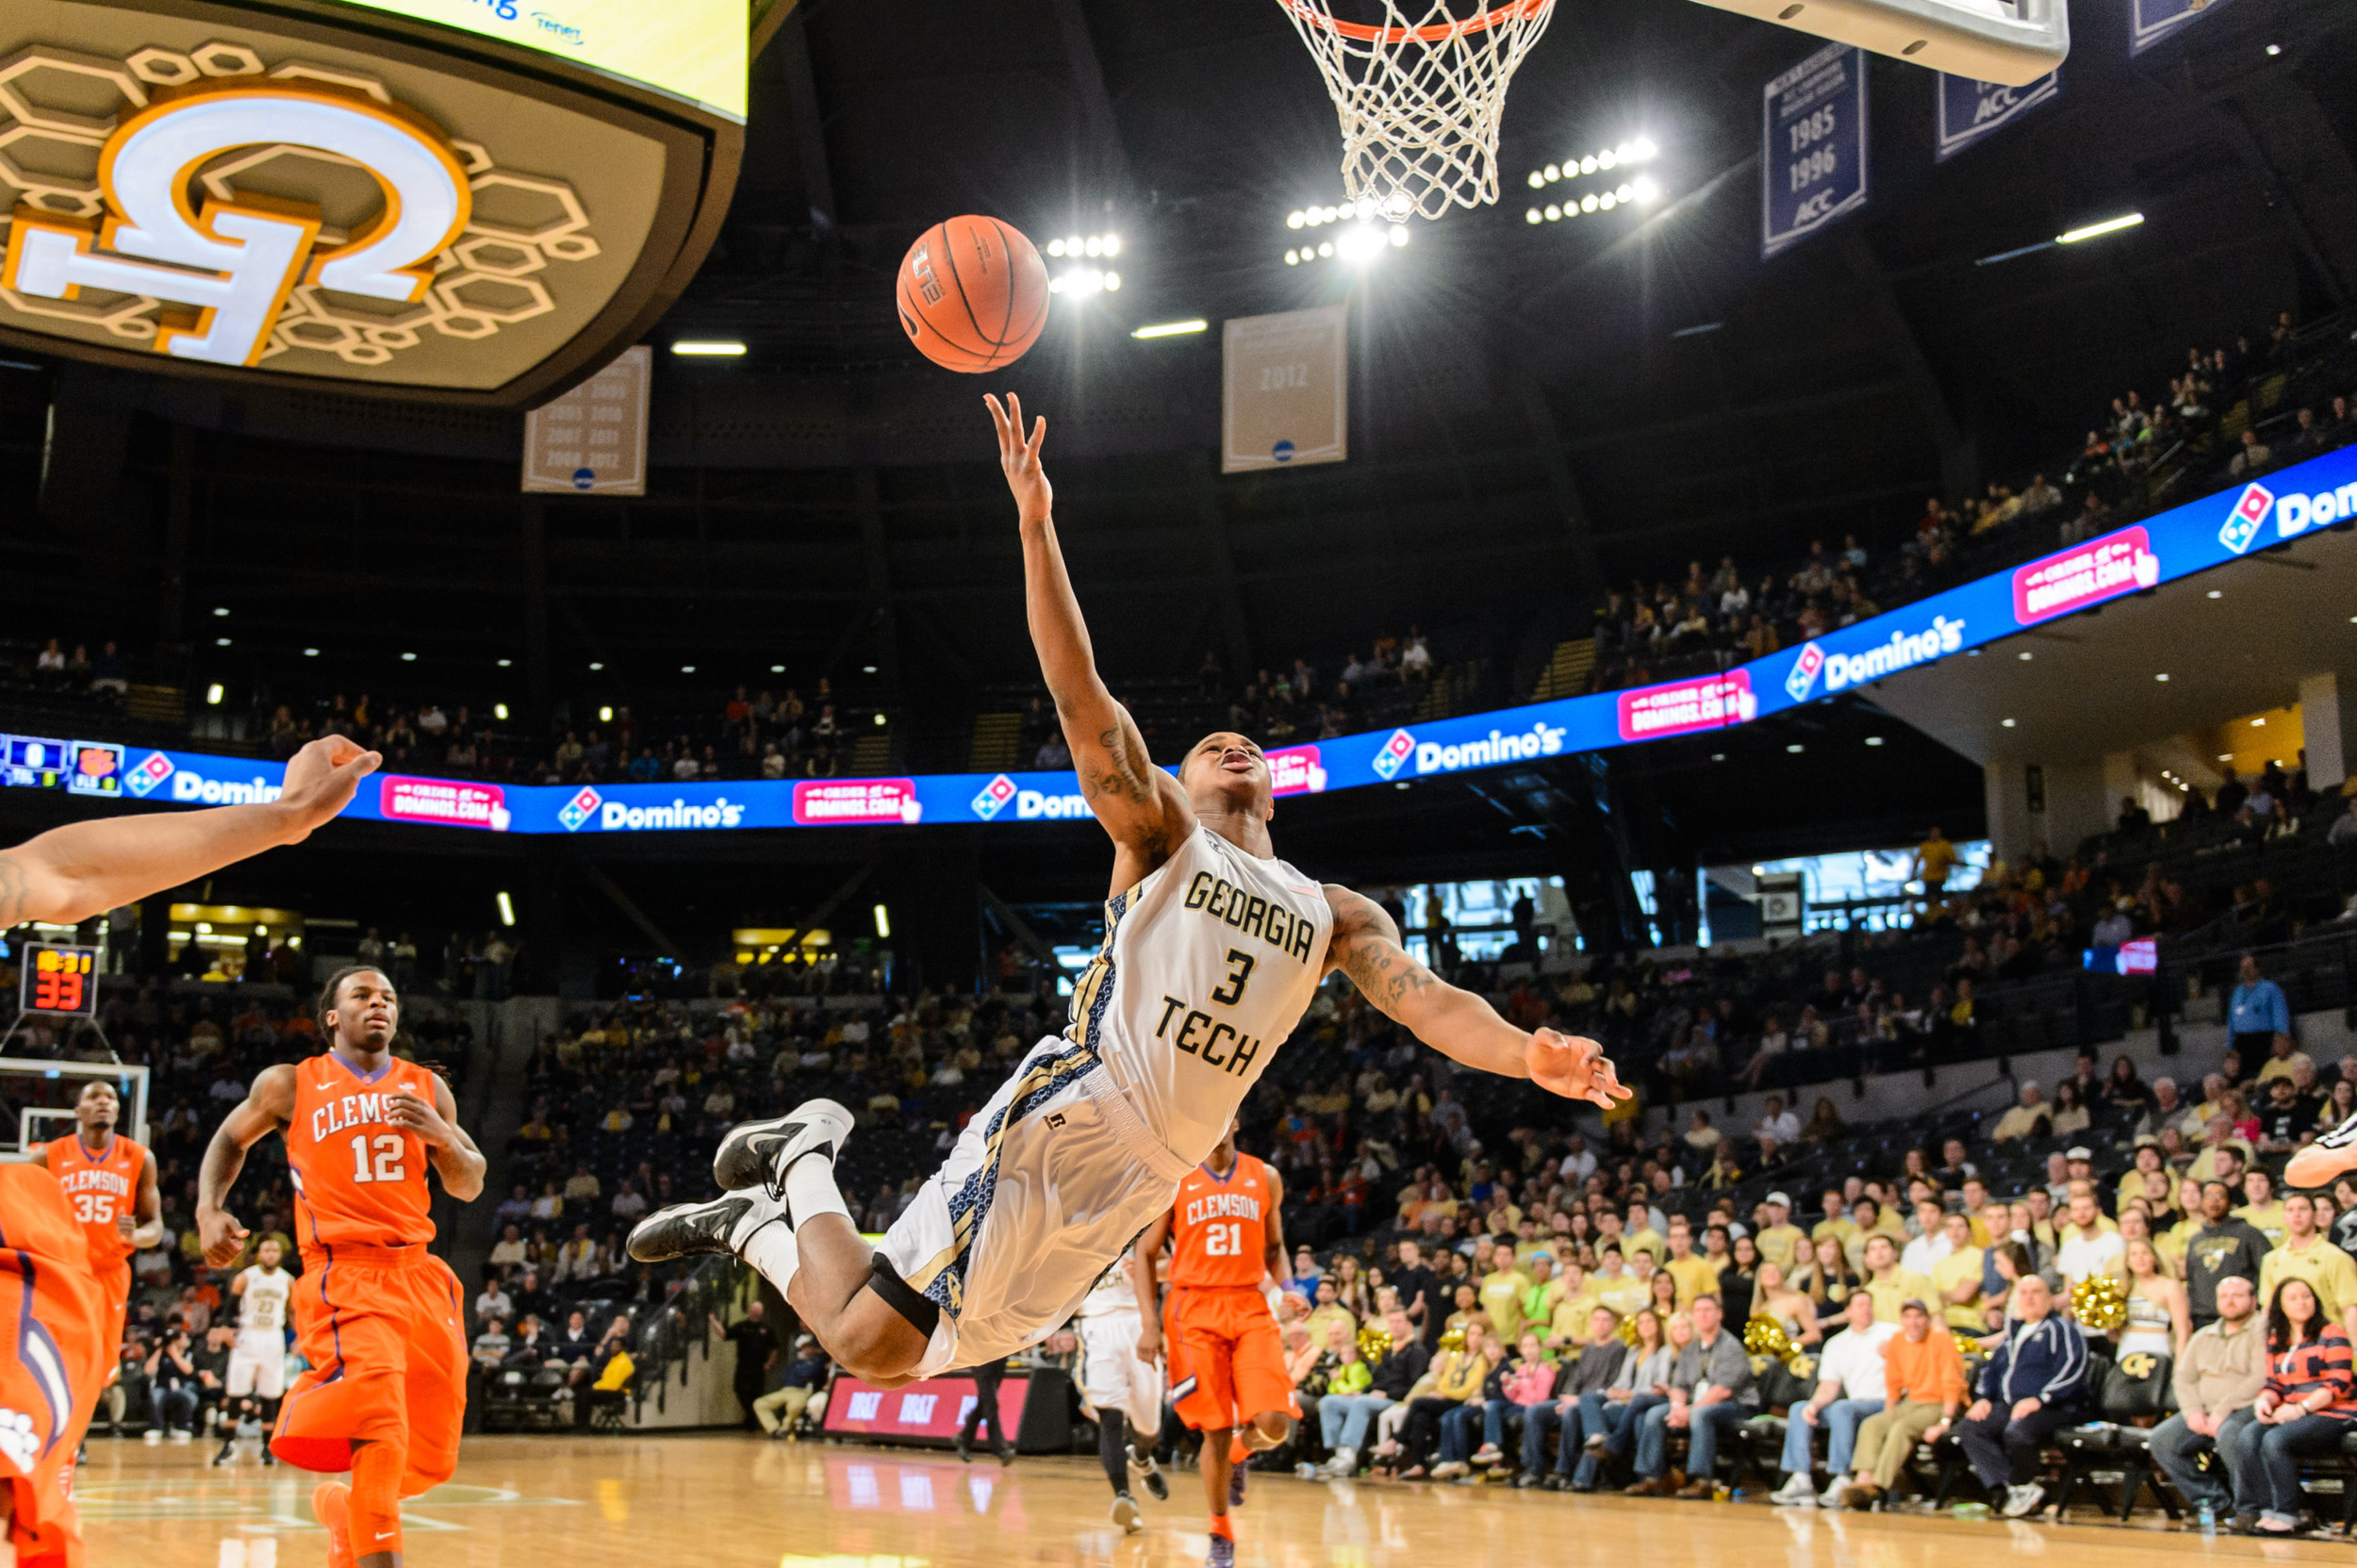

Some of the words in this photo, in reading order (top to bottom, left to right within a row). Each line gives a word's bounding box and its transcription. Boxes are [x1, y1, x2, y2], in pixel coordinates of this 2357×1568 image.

[1973, 86, 2019, 124] ACC
[1788, 103, 1837, 154] 1985
[1788, 142, 1837, 191] 1996
[1793, 188, 1836, 227] ACC
[1259, 361, 1310, 393] 2012
[1823, 615, 1964, 691] Domino's
[1415, 721, 1563, 774] Domino's
[172, 769, 283, 805] Domin
[394, 795, 489, 819] DOMINOS.COM
[601, 797, 743, 830] Domino's
[805, 798, 899, 817] DOMINOS.COM
[1183, 870, 1316, 966] GEORGIA
[35, 970, 83, 1011] 33
[1211, 947, 1256, 1007] 3
[1155, 994, 1261, 1078] TECH
[312, 1093, 399, 1144] CLEMS
[350, 1133, 405, 1183] 12
[60, 1169, 129, 1197] CLEMSON
[74, 1194, 116, 1225] 35
[1187, 1193, 1260, 1226] CLEMSON
[1205, 1222, 1243, 1256] 21
